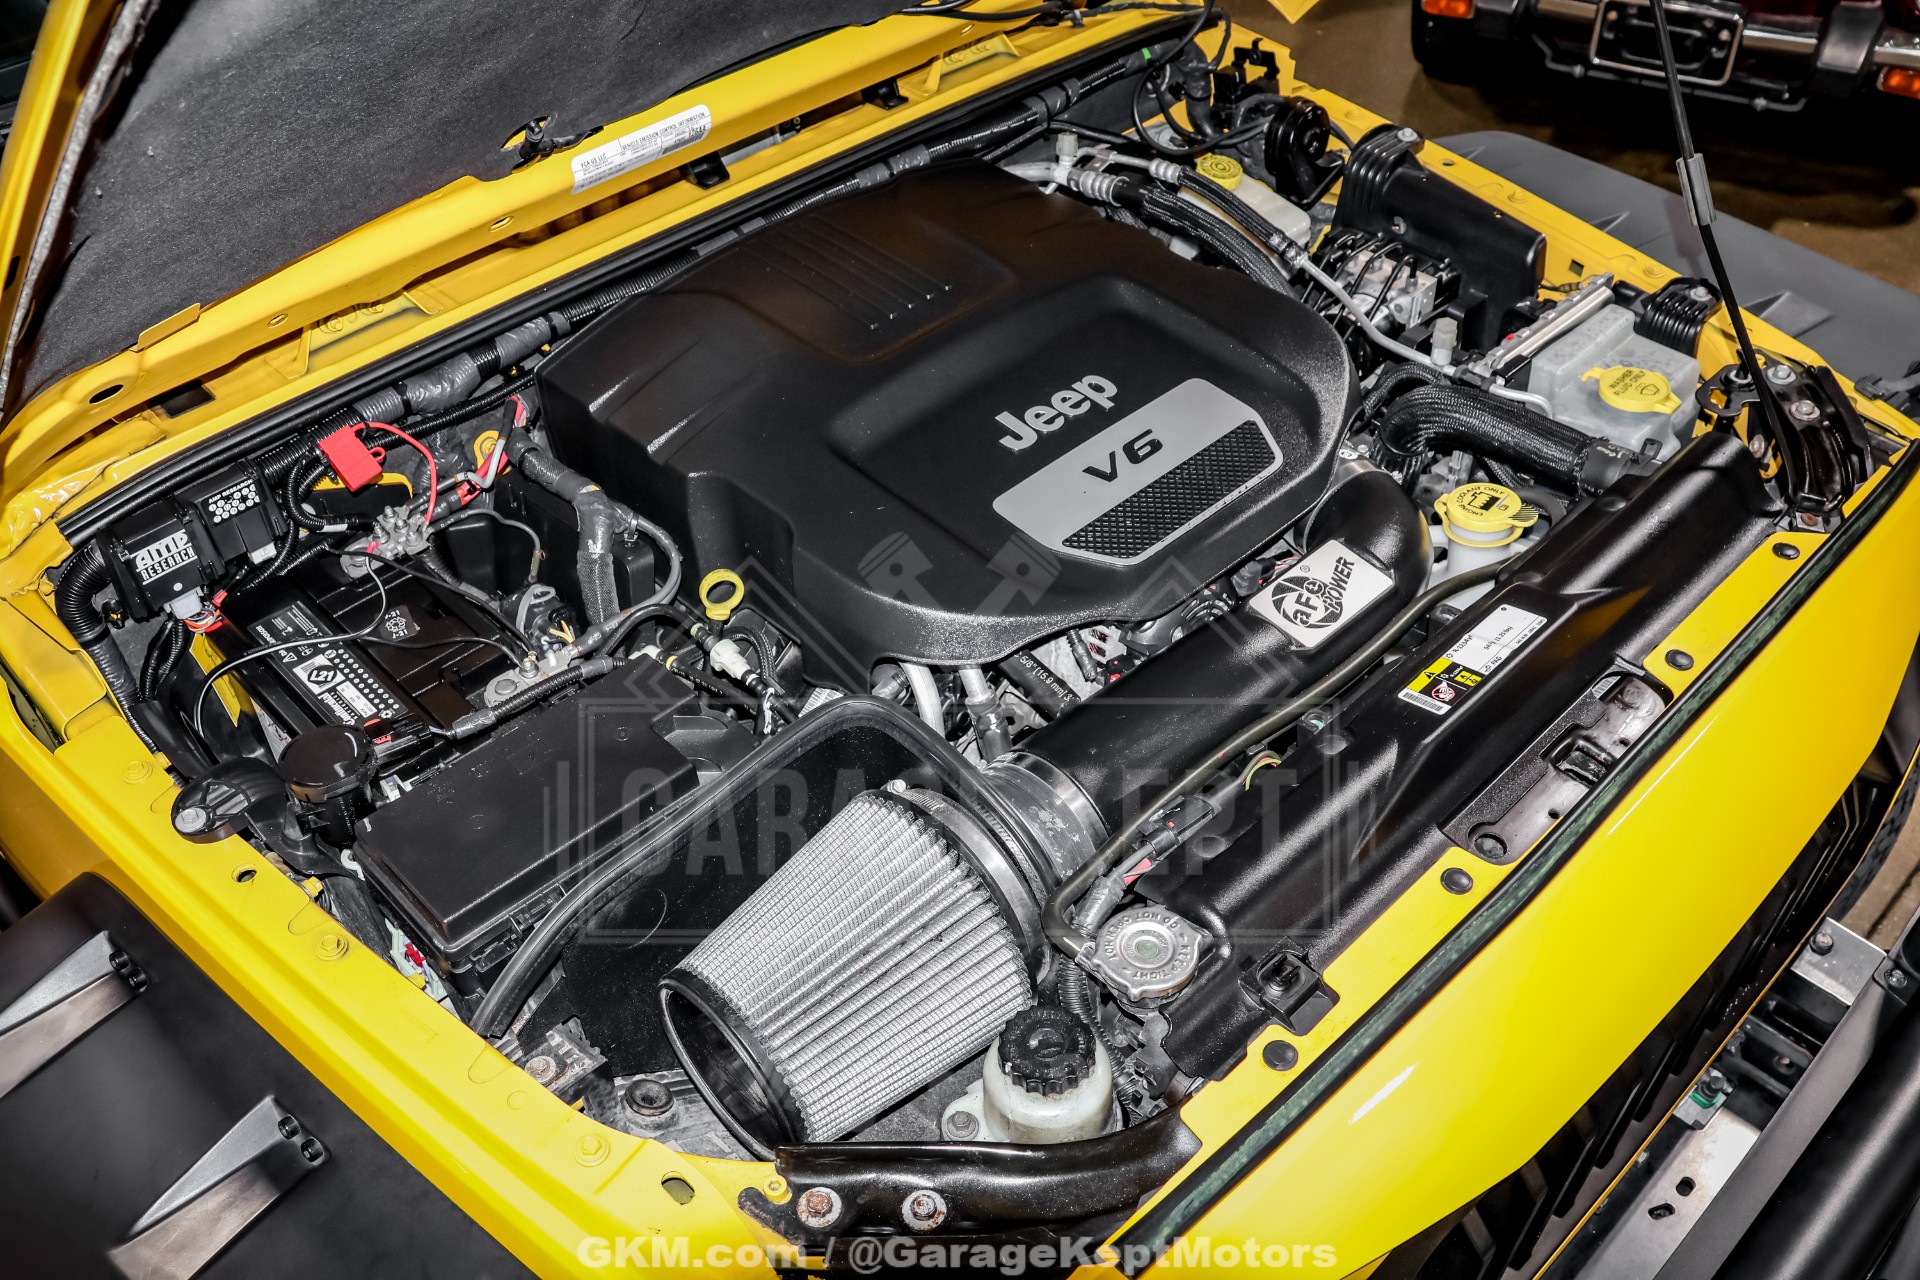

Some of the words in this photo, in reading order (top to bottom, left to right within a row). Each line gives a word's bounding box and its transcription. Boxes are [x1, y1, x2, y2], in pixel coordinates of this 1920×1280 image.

[622, 141, 640, 151] VEHICLE
[639, 131, 660, 143] EMISSION
[659, 124, 678, 137] CONTROL
[678, 112, 706, 129] INFORMATION
[580, 160, 591, 169] FCA
[1609, 369, 1633, 389] WASHER
[1613, 382, 1633, 396] FLUID
[1629, 370, 1646, 383] ONLY
[995, 374, 1118, 451] Jeep
[1082, 429, 1163, 483] V6
[208, 494, 222, 504] AMP
[221, 479, 253, 497] RESEARCH
[1457, 486, 1481, 503] COOLANT
[1483, 486, 1505, 495] ONLY
[1458, 503, 1484, 517] ENGINE
[132, 529, 191, 572] AMP
[141, 546, 196, 581] RESEARCH
[1322, 556, 1356, 612] POWER
[1292, 579, 1325, 626] aFe
[392, 629, 408, 639] J-21
[1452, 634, 1473, 653] R-1234yf
[1020, 655, 1037, 668] 5/8"
[1490, 656, 1503, 666] PAG
[309, 670, 335, 682] L21
[317, 692, 356, 726] Continental
[330, 691, 359, 720] BATTERIES
[1136, 911, 1161, 921] NOT
[1163, 916, 1180, 929] DO
[1105, 915, 1132, 940] OPEN
[1104, 941, 1120, 961] HOT
[1171, 944, 1192, 973] KEEP
[1132, 969, 1171, 979] TIGHT
